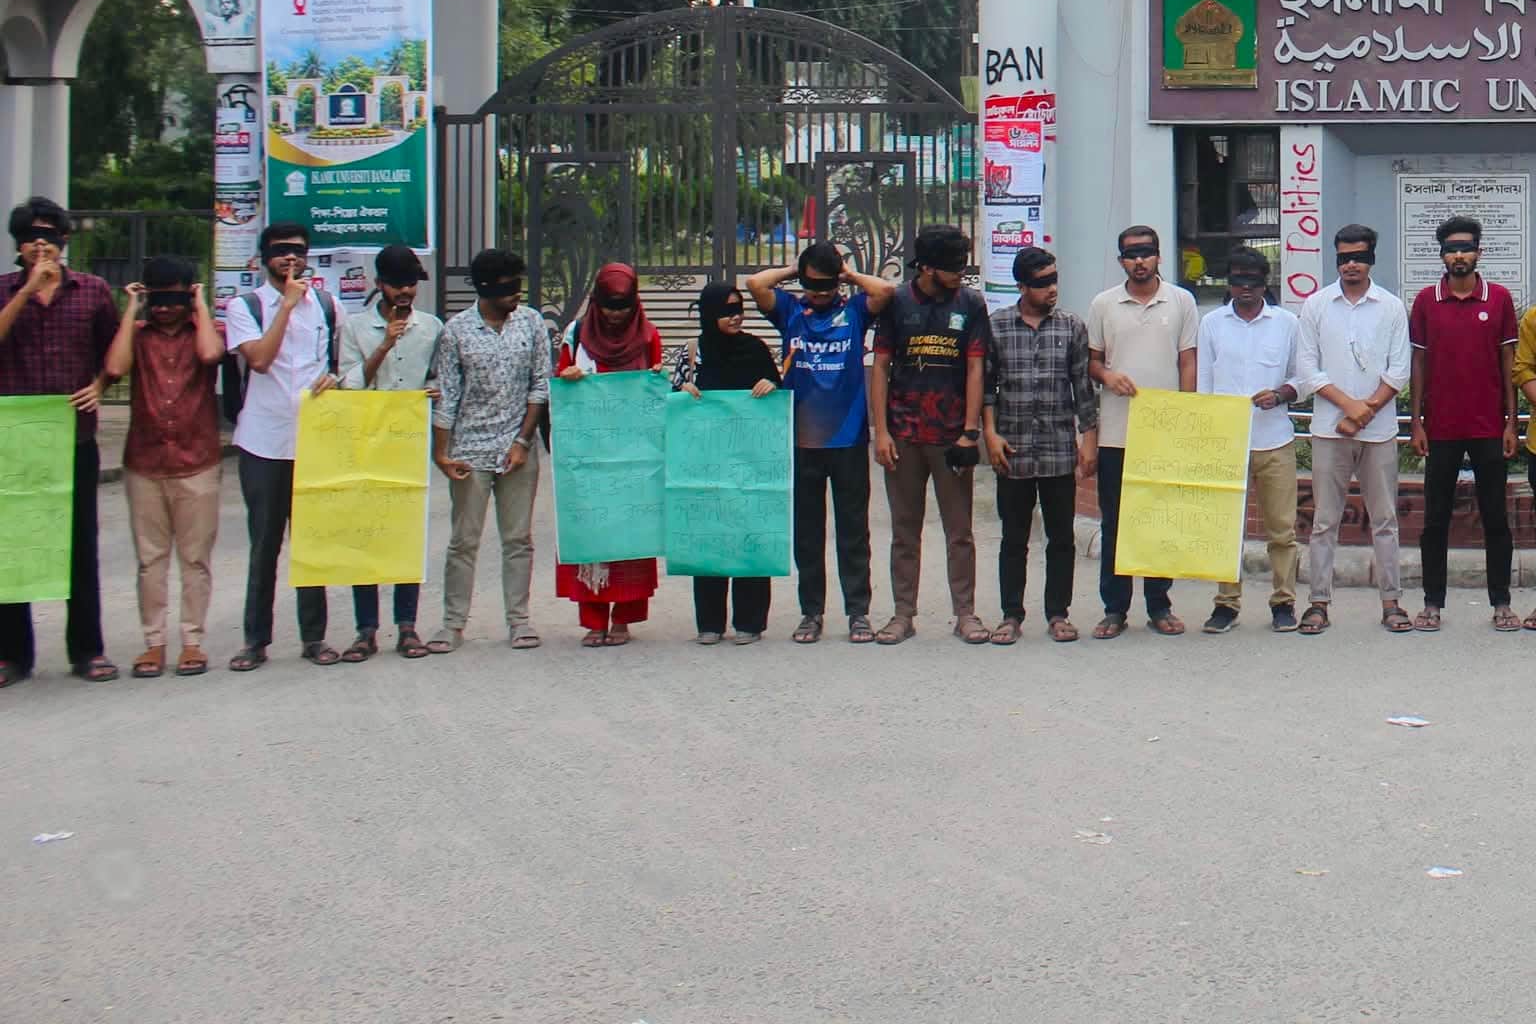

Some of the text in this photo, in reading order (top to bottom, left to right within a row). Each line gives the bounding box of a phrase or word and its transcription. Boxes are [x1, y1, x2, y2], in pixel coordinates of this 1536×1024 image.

[985, 46, 1044, 85] BAN
[1274, 79, 1462, 113] ISLAMIC
[1281, 142, 1322, 256] Politics
[1404, 183, 1446, 195] ইসলামী
